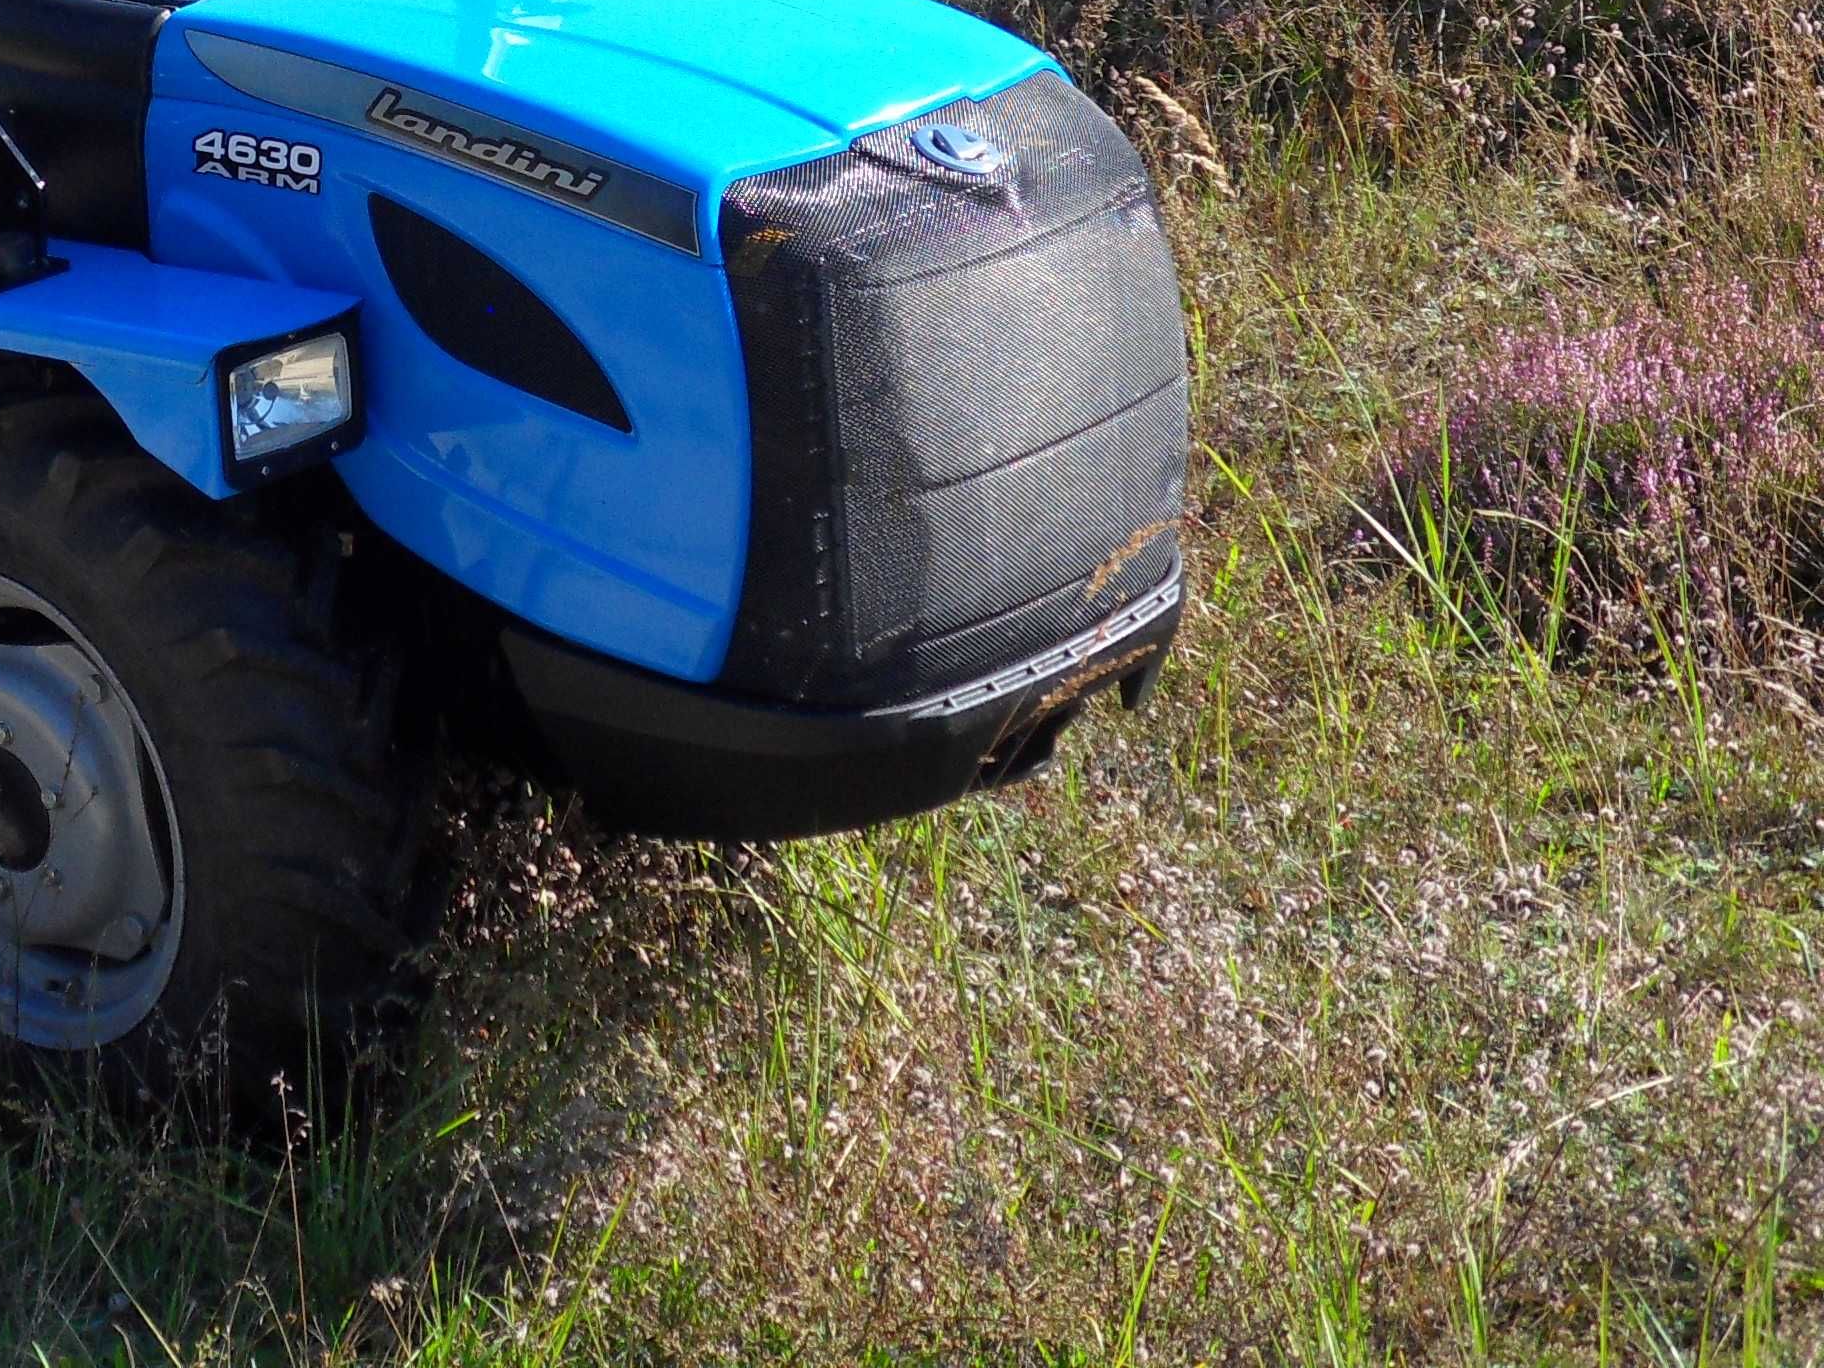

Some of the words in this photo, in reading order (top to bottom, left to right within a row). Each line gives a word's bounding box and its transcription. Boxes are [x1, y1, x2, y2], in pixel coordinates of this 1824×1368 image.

[194, 131, 320, 176] 4630
[370, 91, 603, 197] Landini
[196, 160, 319, 194] ARM
